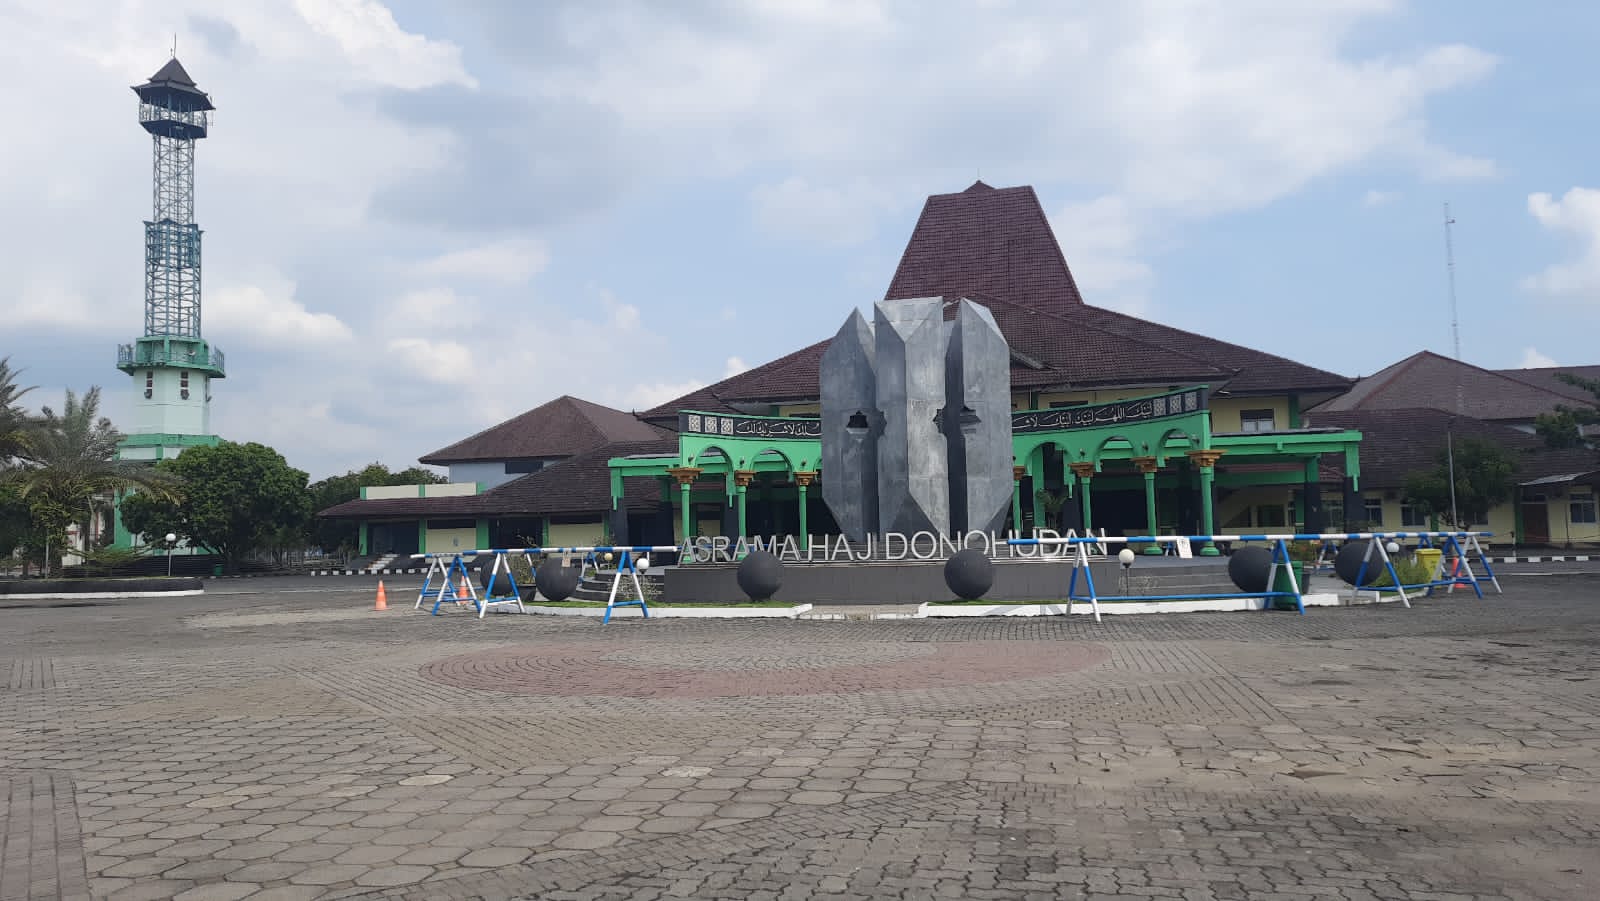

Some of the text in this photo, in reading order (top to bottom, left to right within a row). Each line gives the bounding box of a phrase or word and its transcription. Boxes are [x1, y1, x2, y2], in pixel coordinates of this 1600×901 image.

[678, 527, 1108, 563] ASRAMA HAJI DONOHUDAN
